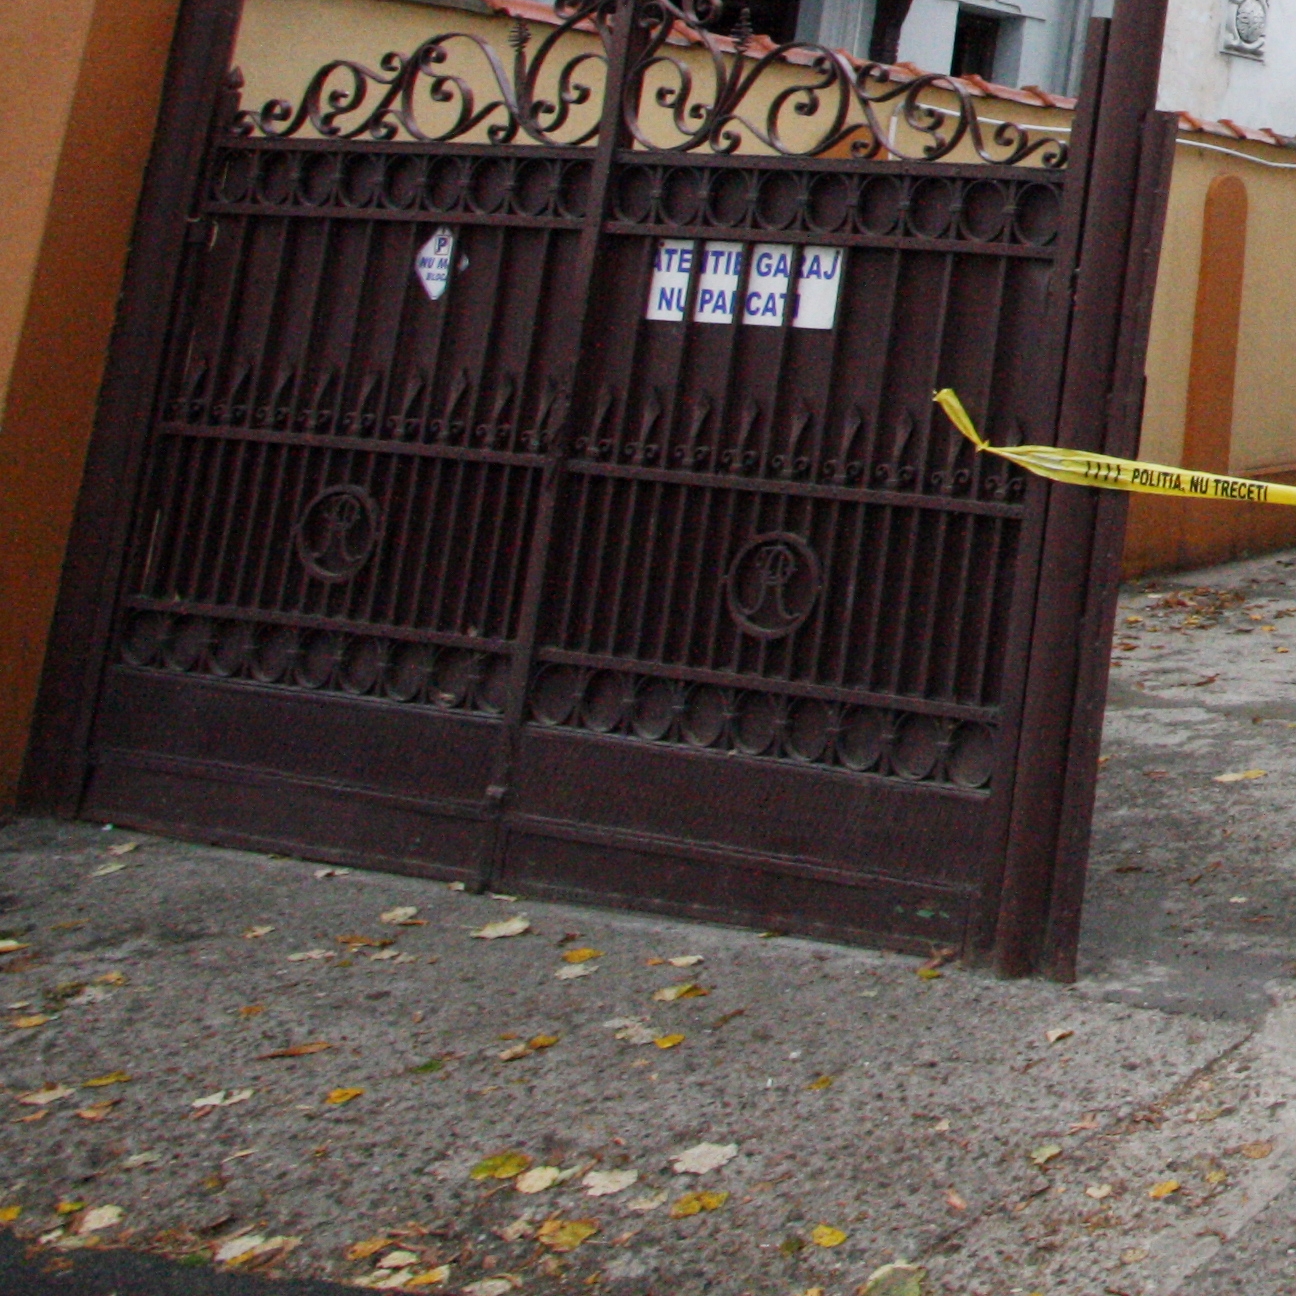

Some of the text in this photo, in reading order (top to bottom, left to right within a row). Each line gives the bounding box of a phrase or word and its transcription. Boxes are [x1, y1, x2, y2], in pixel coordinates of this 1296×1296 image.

[437, 236, 448, 253] P
[657, 286, 688, 313] NU
[1189, 475, 1210, 495] NU
[1213, 478, 1269, 502] TRECETI
